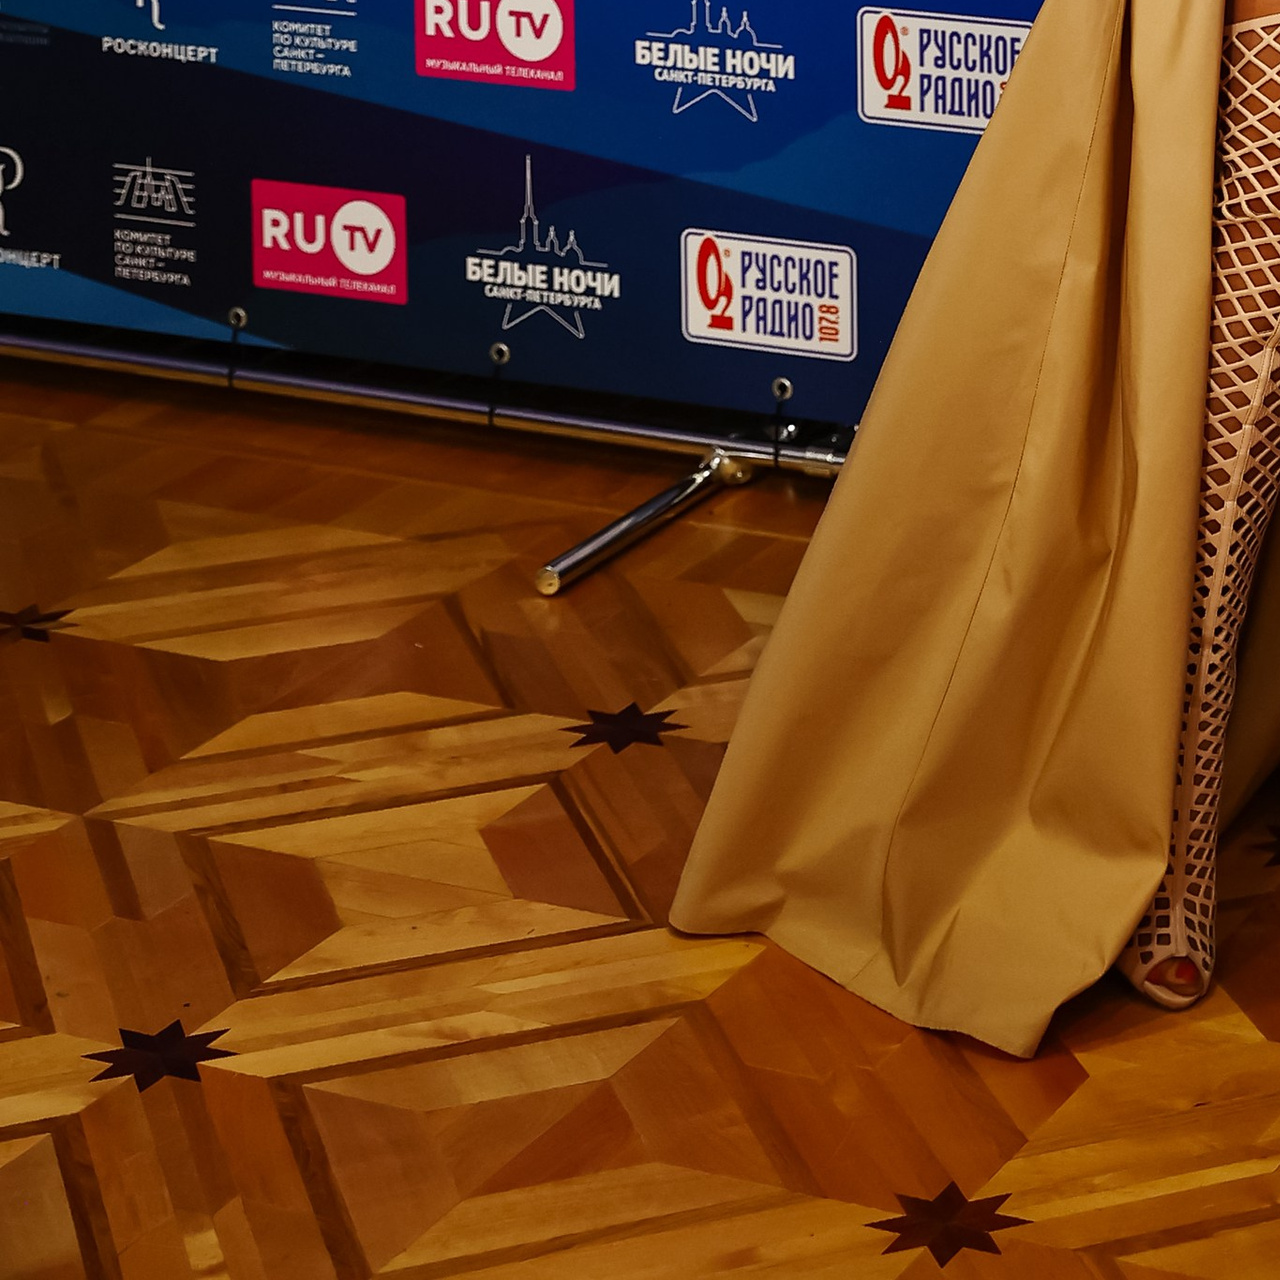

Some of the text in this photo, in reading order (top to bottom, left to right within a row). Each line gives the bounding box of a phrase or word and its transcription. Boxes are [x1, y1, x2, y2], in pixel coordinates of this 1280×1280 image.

[101, 36, 218, 65] РОСКОНЦЕРТ
[634, 38, 795, 81] БЕЛЫЕ НОЧИ
[654, 66, 776, 93] САНКТ-ПЕТЕРБУРГА
[740, 250, 839, 299] РУССКОЕ
[740, 294, 814, 342] РАДИО
